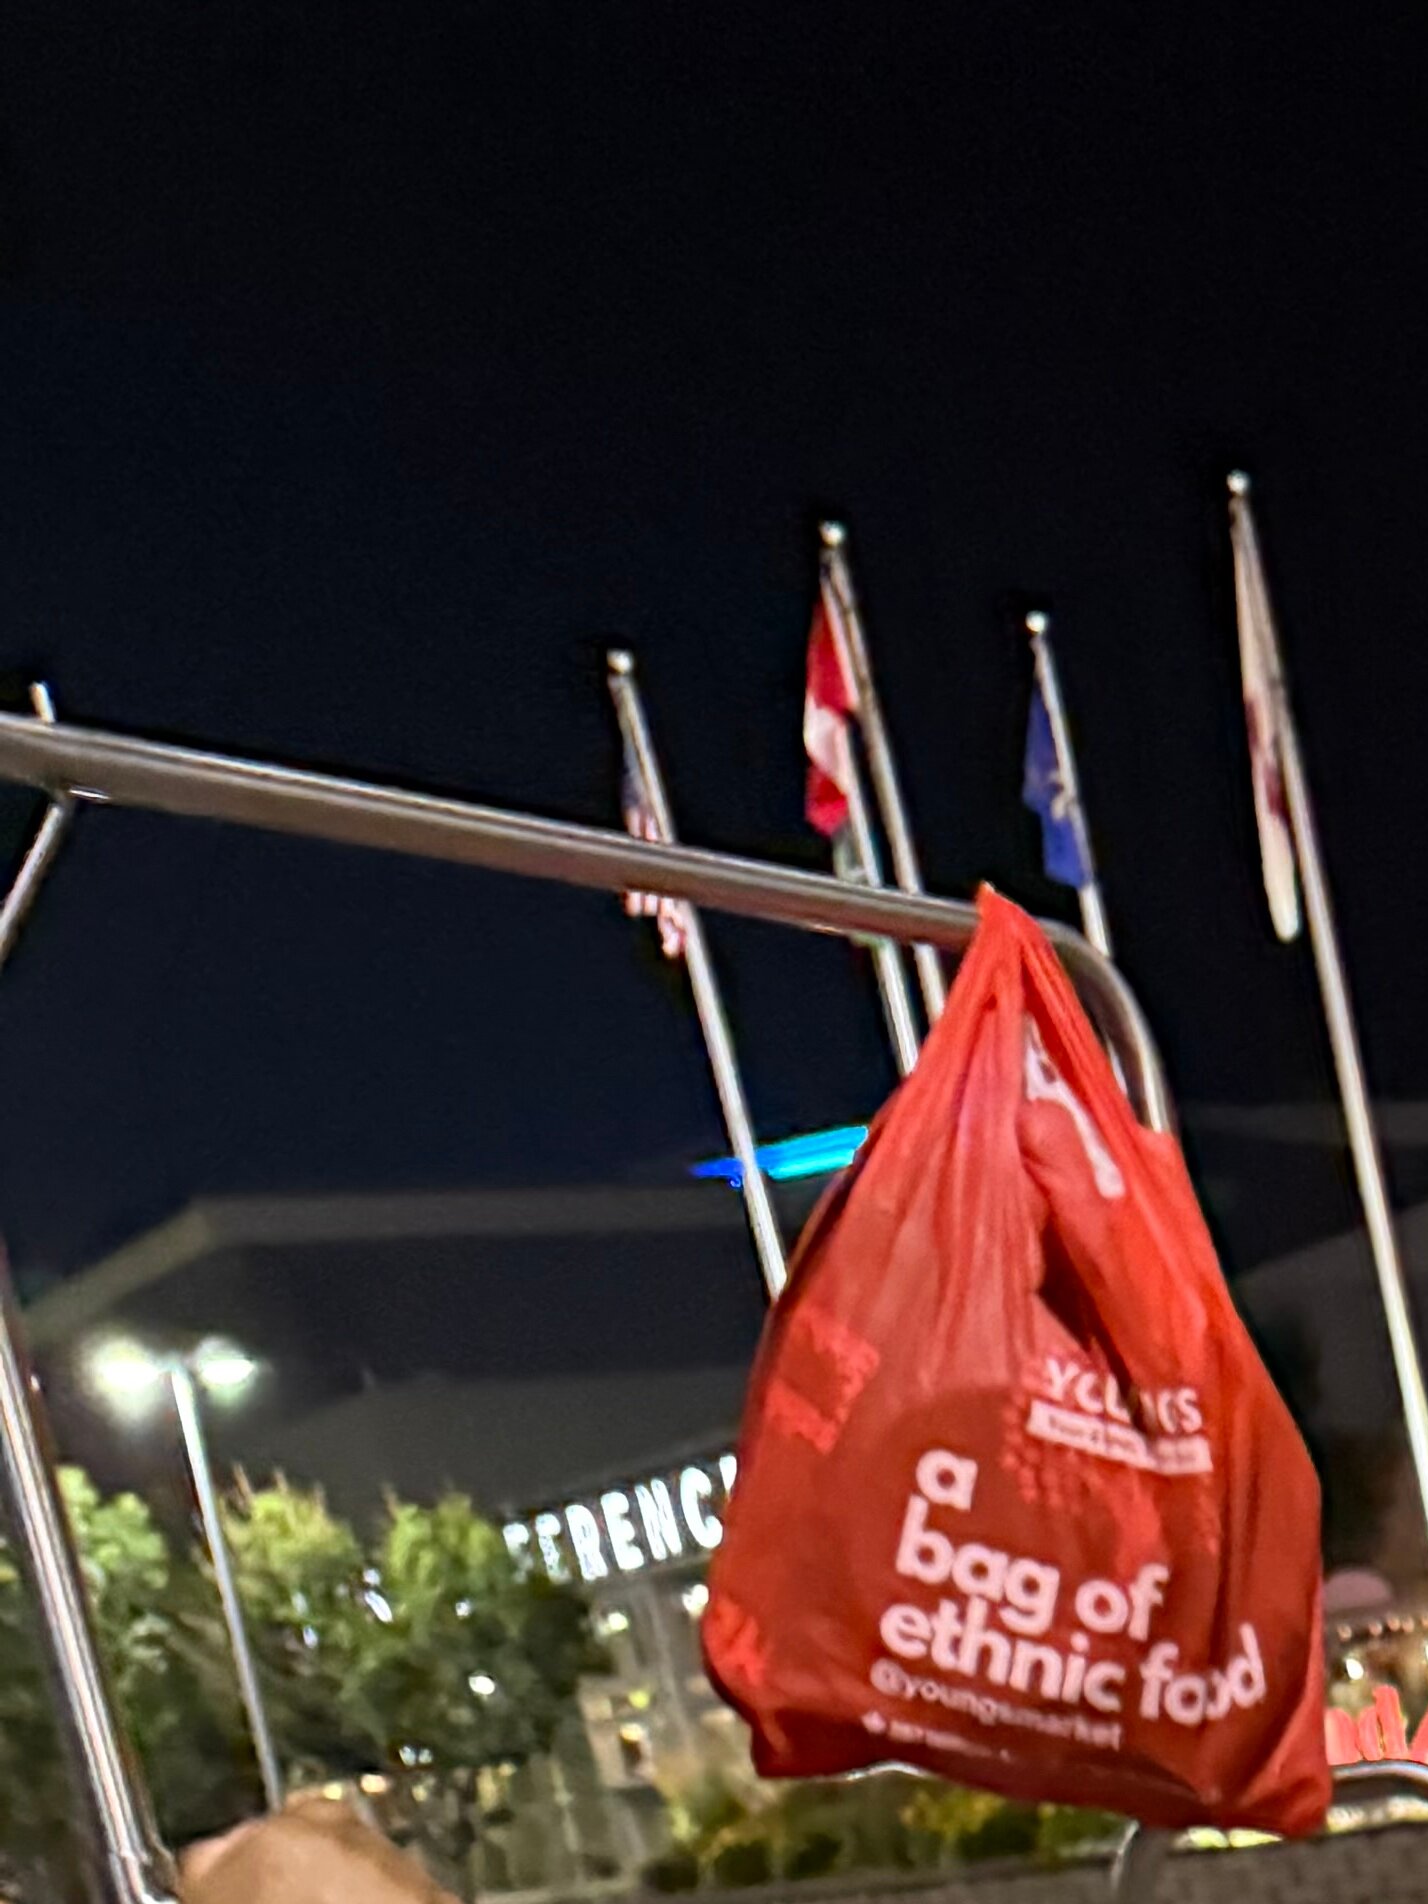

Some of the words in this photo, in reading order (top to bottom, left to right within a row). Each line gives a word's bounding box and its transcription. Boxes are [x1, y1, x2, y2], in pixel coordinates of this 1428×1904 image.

[915, 1448, 979, 1512] a
[896, 1494, 1060, 1636] bag
[1075, 1562, 1170, 1642] of
[879, 1594, 1127, 1713] ethnic
[1139, 1621, 1267, 1726] food
